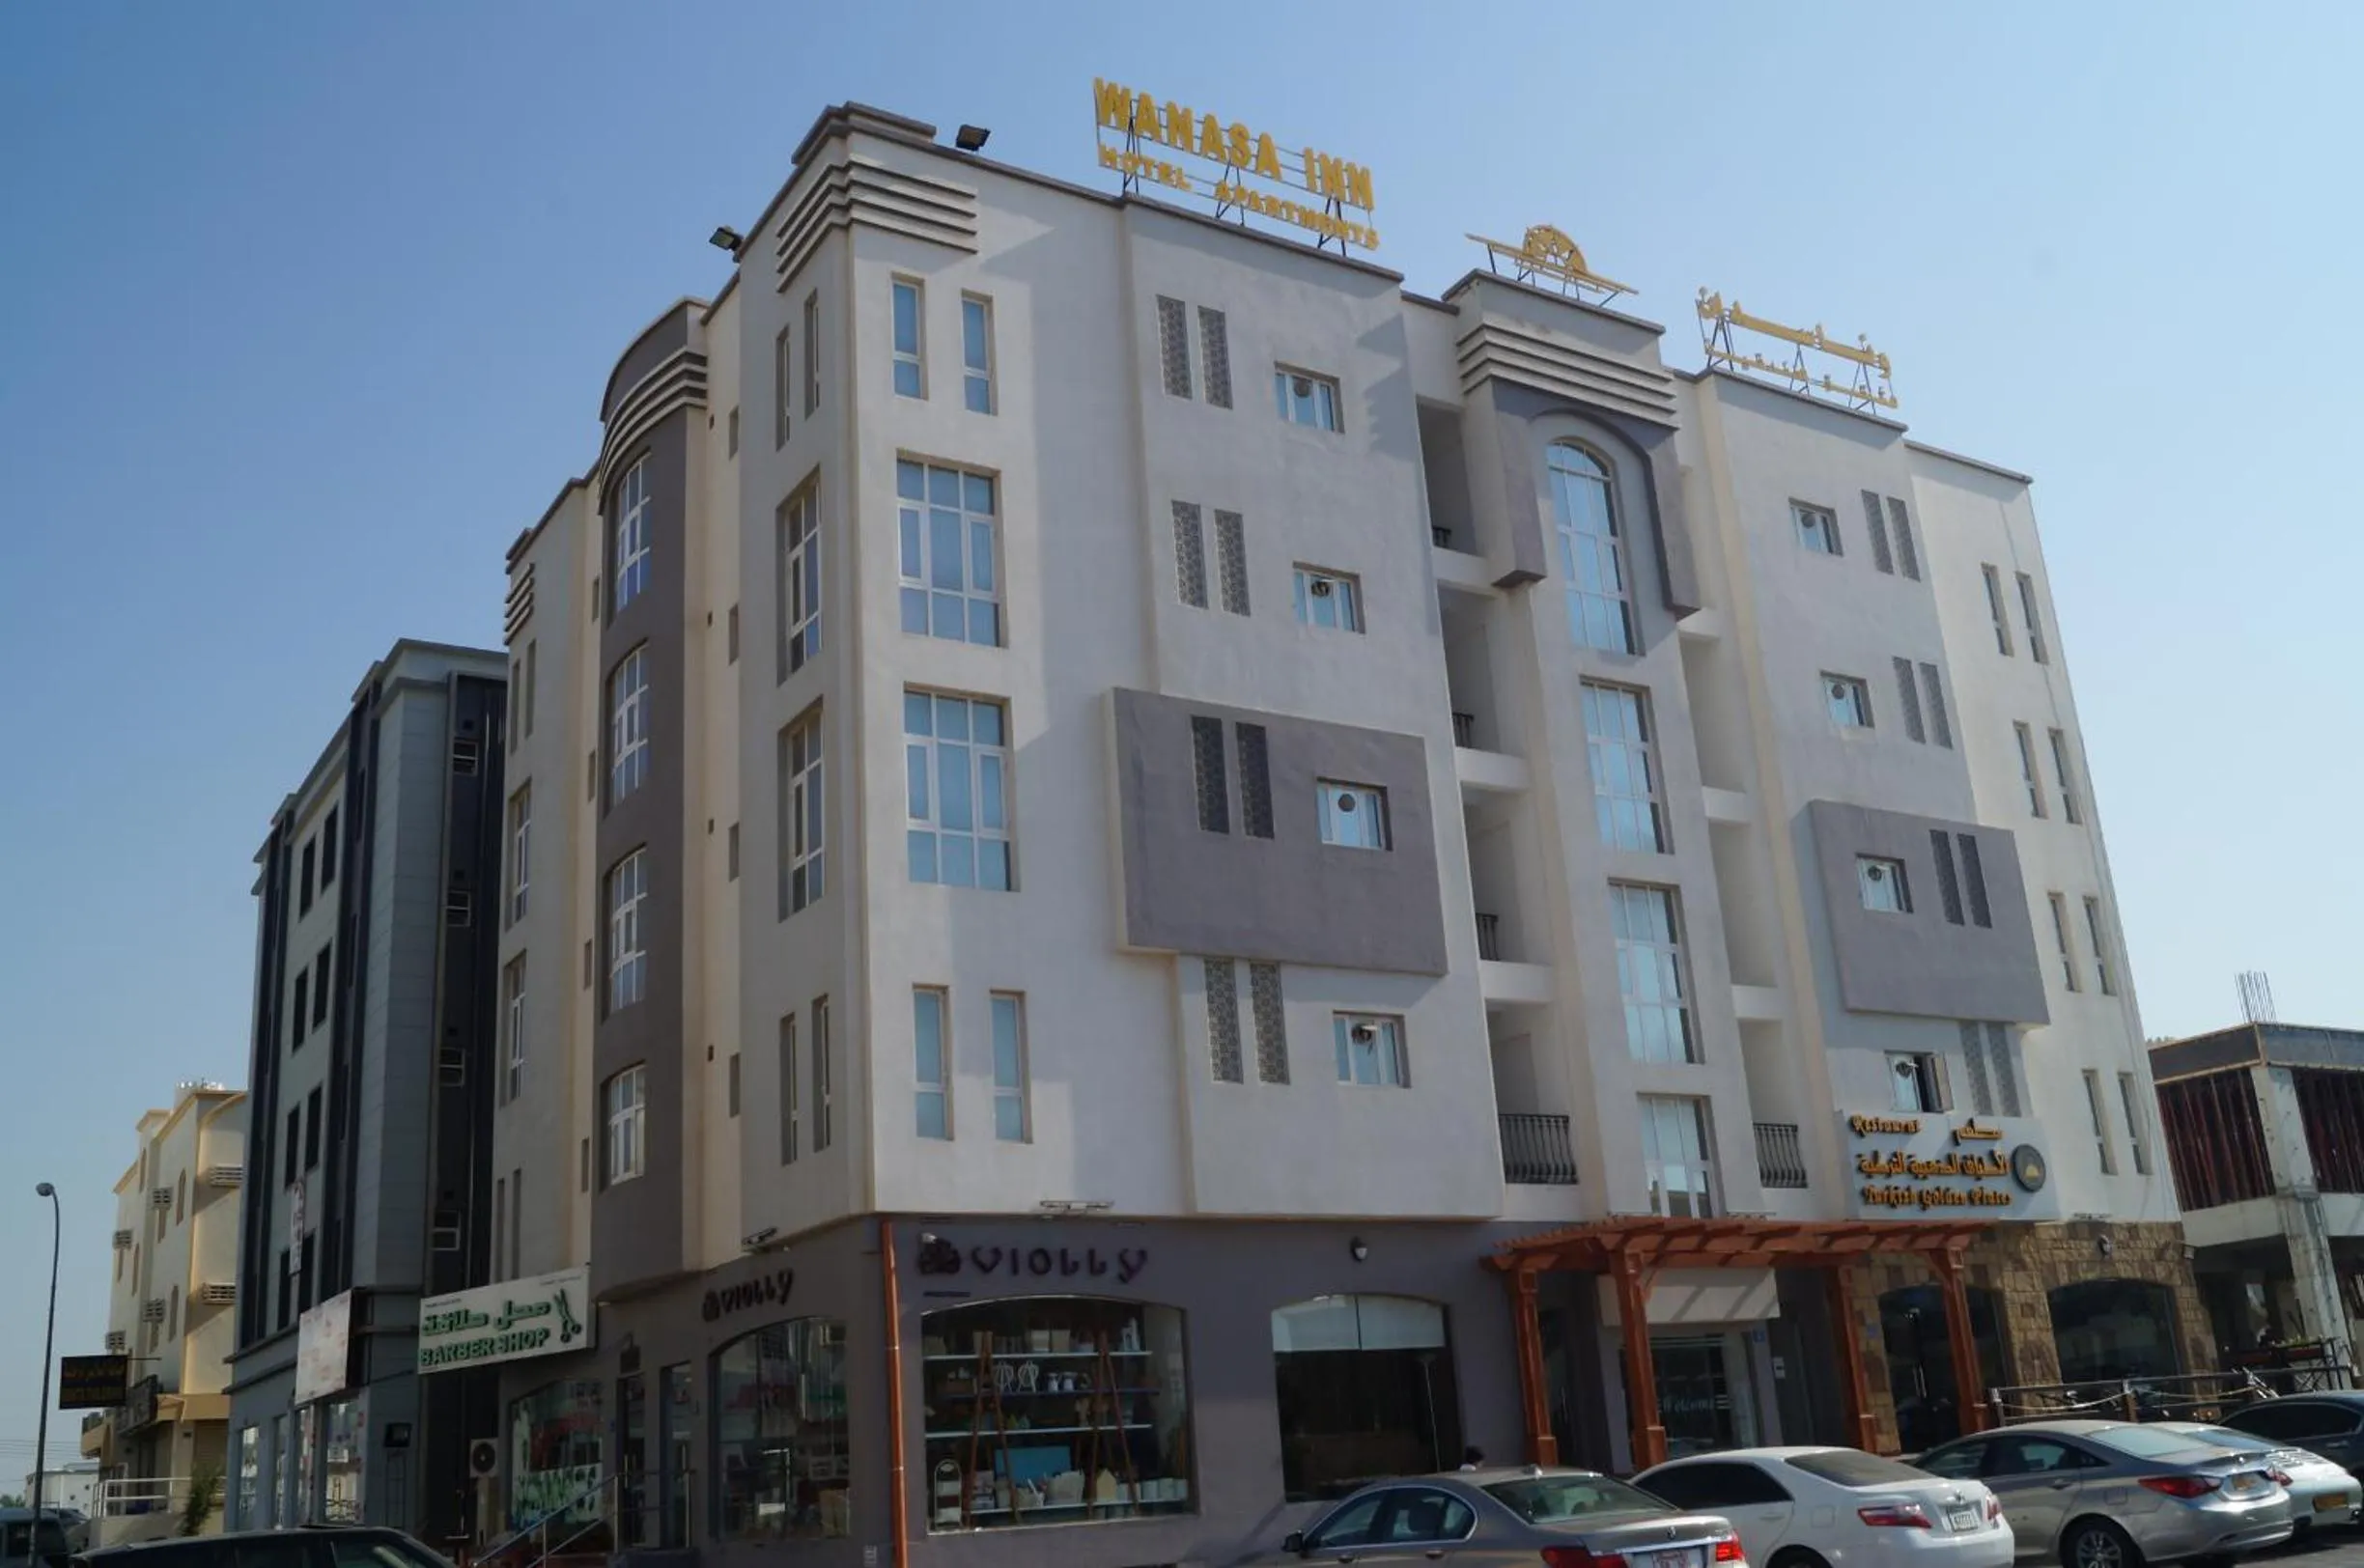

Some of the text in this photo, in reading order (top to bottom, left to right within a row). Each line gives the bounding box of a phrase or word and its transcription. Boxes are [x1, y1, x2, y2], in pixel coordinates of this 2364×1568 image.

[1094, 76, 1373, 210] WANASA INN
[1099, 143, 1379, 251] HOTEL APARTMENTS
[1848, 1114, 1920, 1138] Restaurant
[1952, 1118, 2003, 1146] مطعم
[1861, 1184, 1916, 1209] Turkish
[1917, 1184, 1966, 1211] Golden
[419, 1327, 551, 1366] BARBER SHOP
